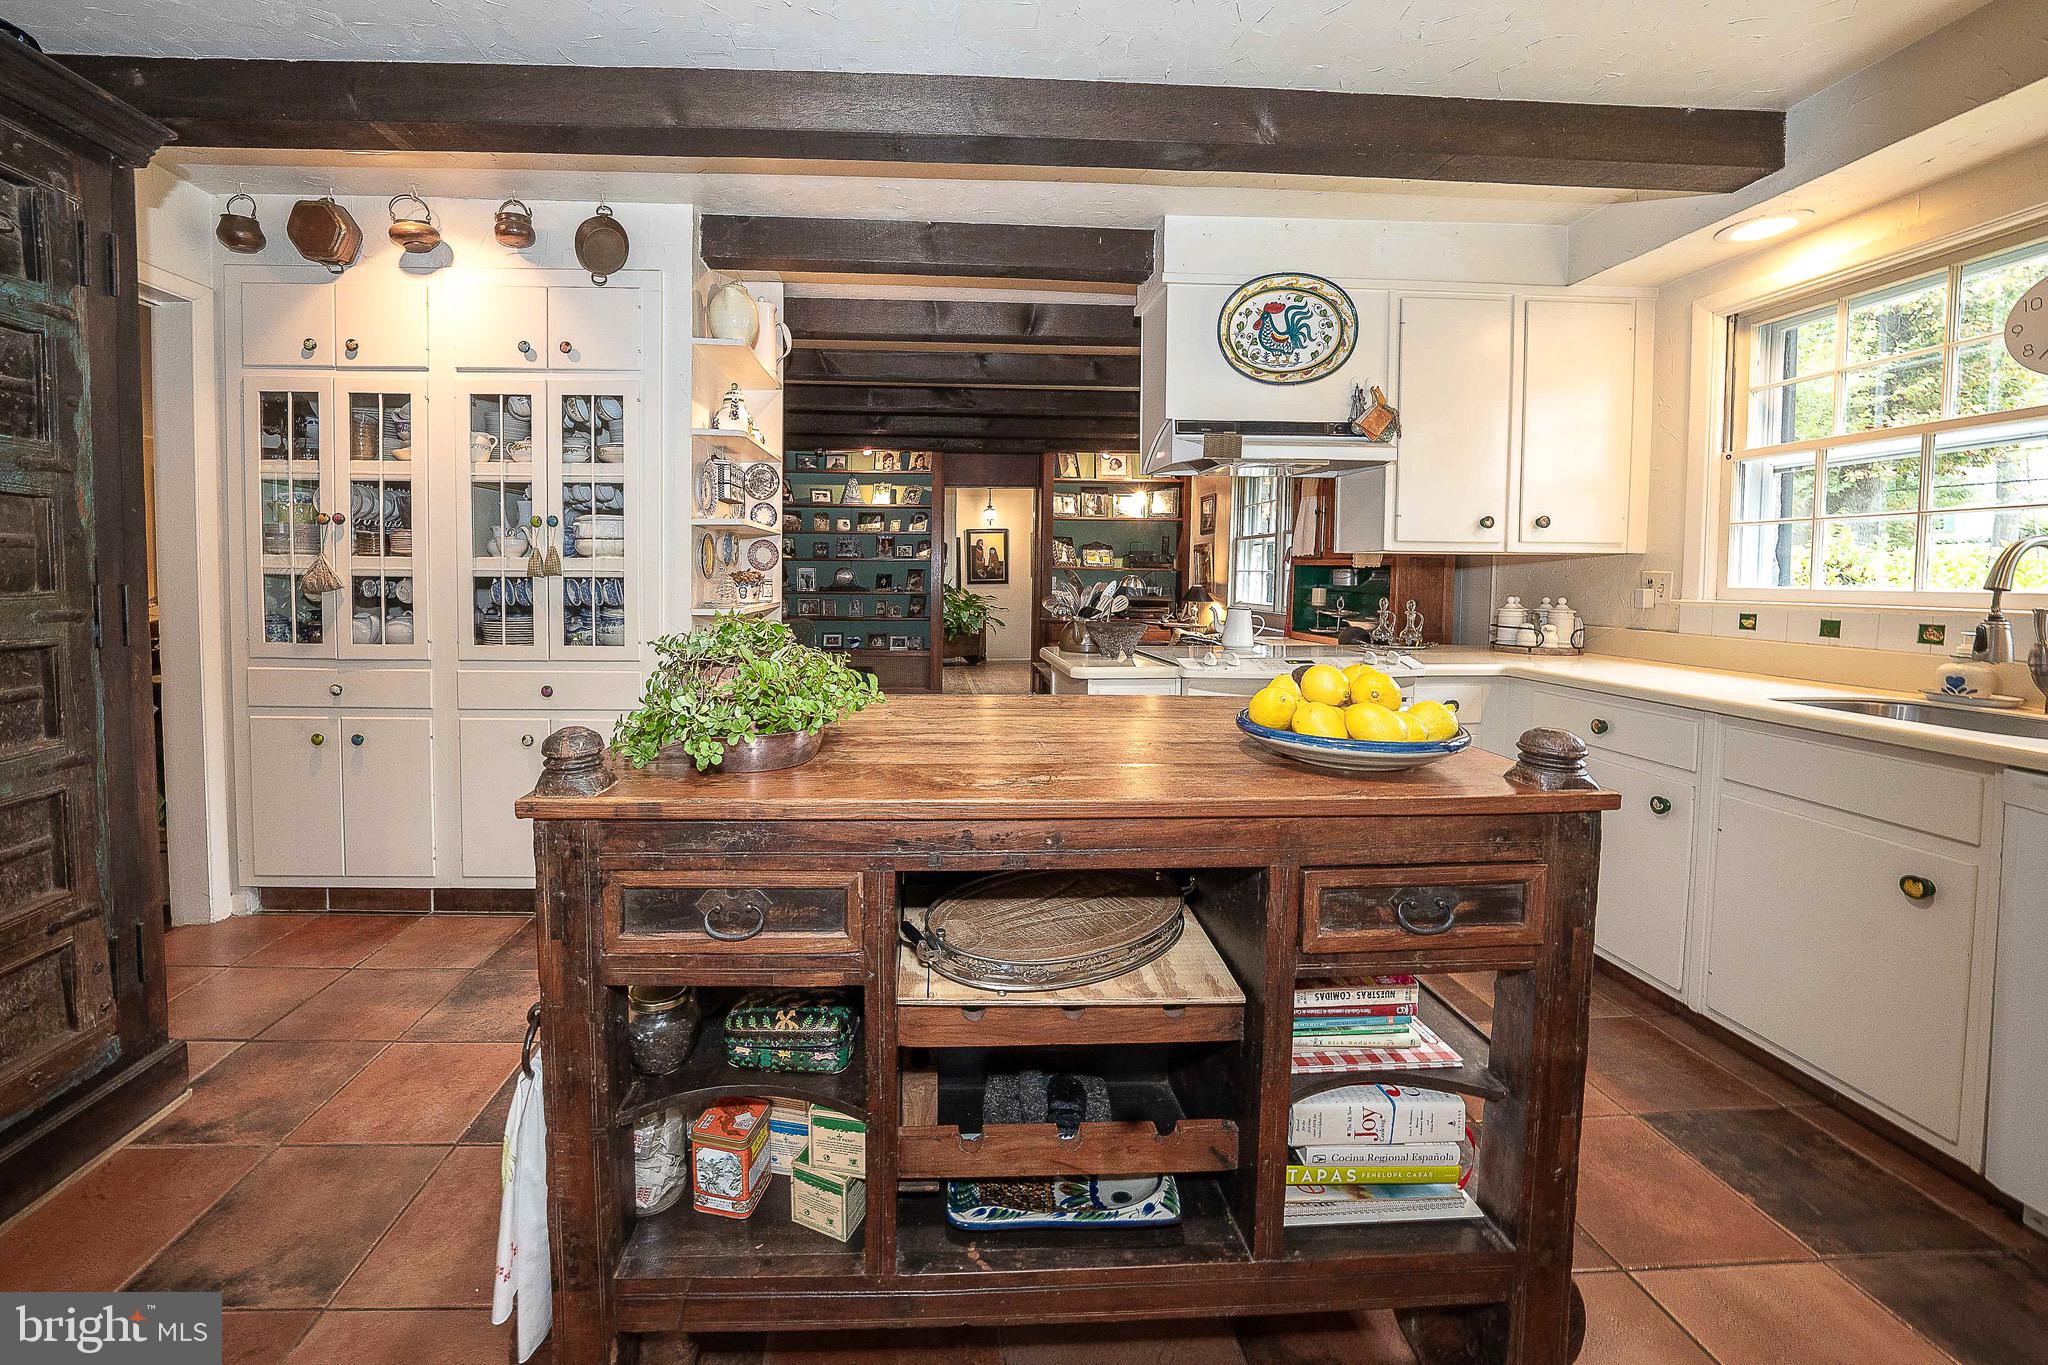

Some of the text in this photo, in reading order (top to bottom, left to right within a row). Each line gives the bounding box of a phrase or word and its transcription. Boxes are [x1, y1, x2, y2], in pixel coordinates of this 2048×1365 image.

[2022, 296, 2043, 313] 10
[2011, 324, 2024, 338] 9
[2022, 343, 2035, 358] 8
[1356, 989, 1396, 1000] NUESTRAS
[1353, 1105, 1383, 1142] Joy
[1331, 1152, 1455, 1164] Cocina Regional Española
[1288, 1169, 1358, 1183] TAPAS
